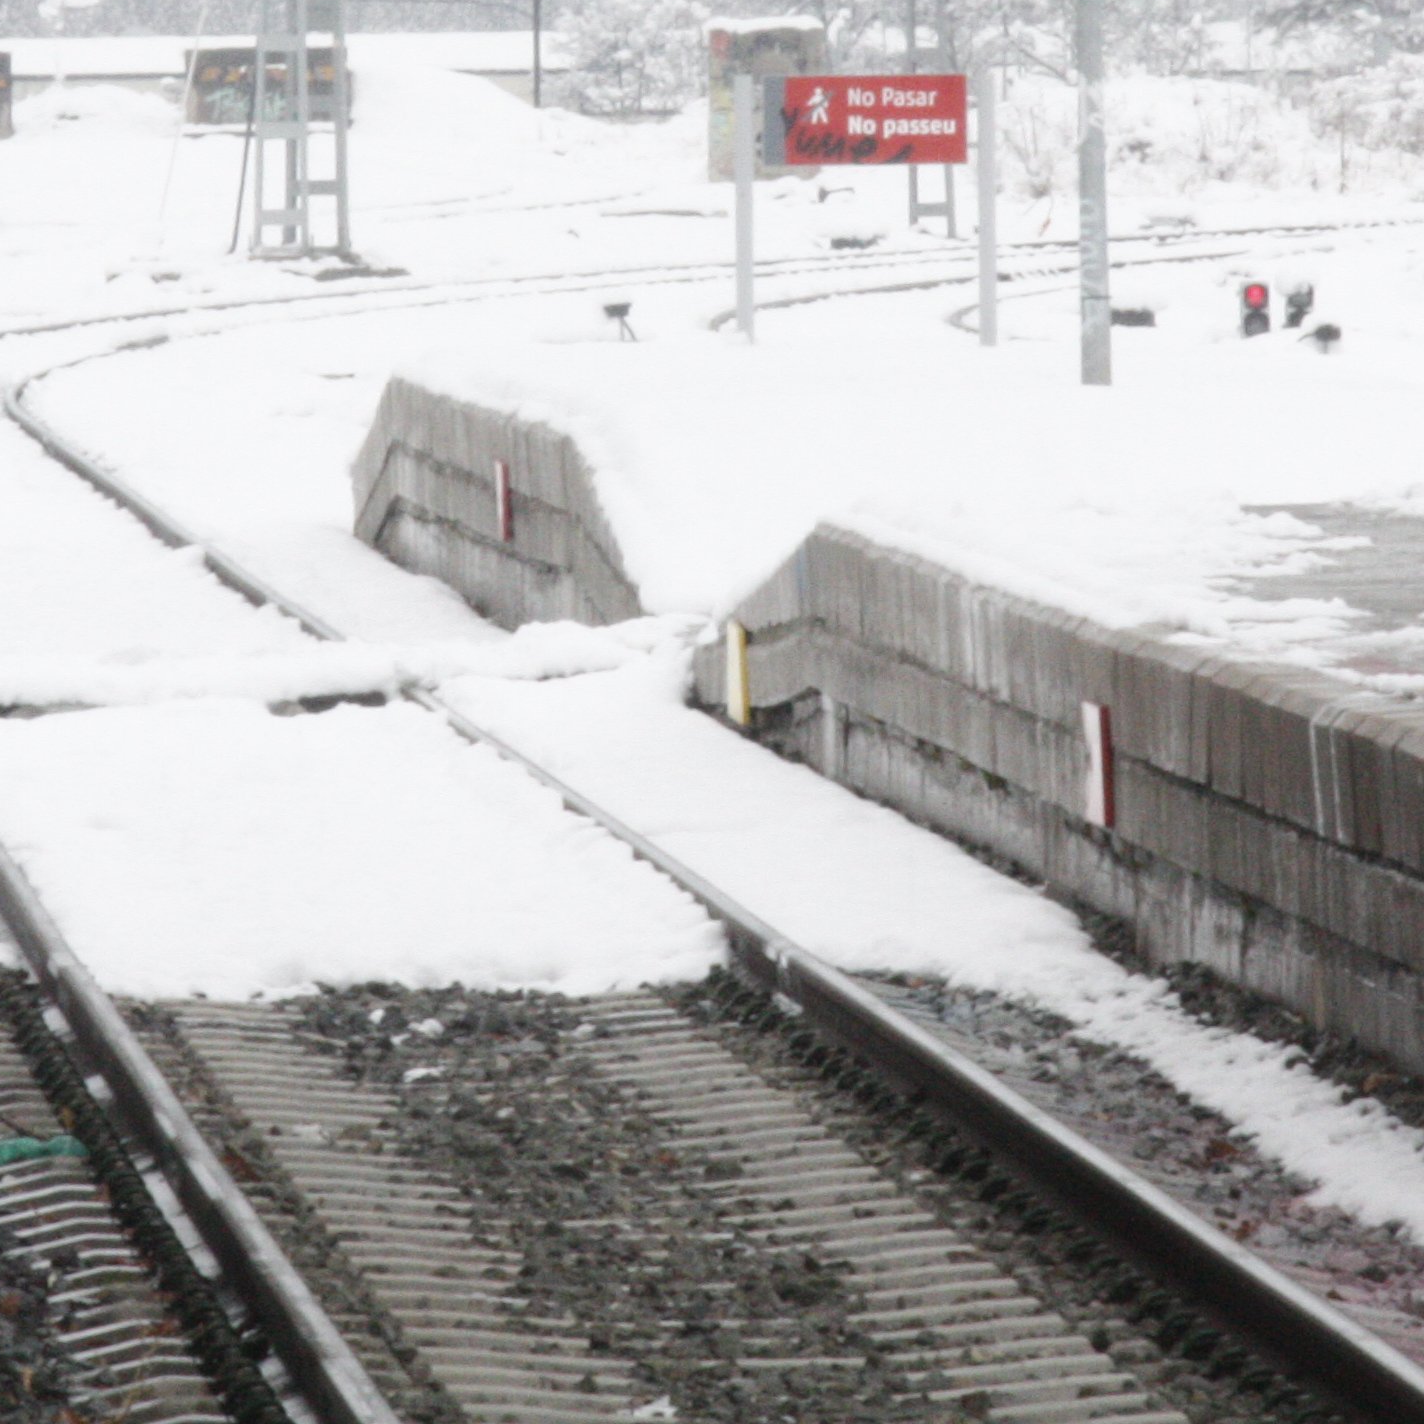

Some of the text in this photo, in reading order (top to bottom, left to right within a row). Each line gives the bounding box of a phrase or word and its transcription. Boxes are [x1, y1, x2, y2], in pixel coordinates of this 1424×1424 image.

[847, 87, 937, 107] No Pasar
[847, 114, 956, 139] No passeu
